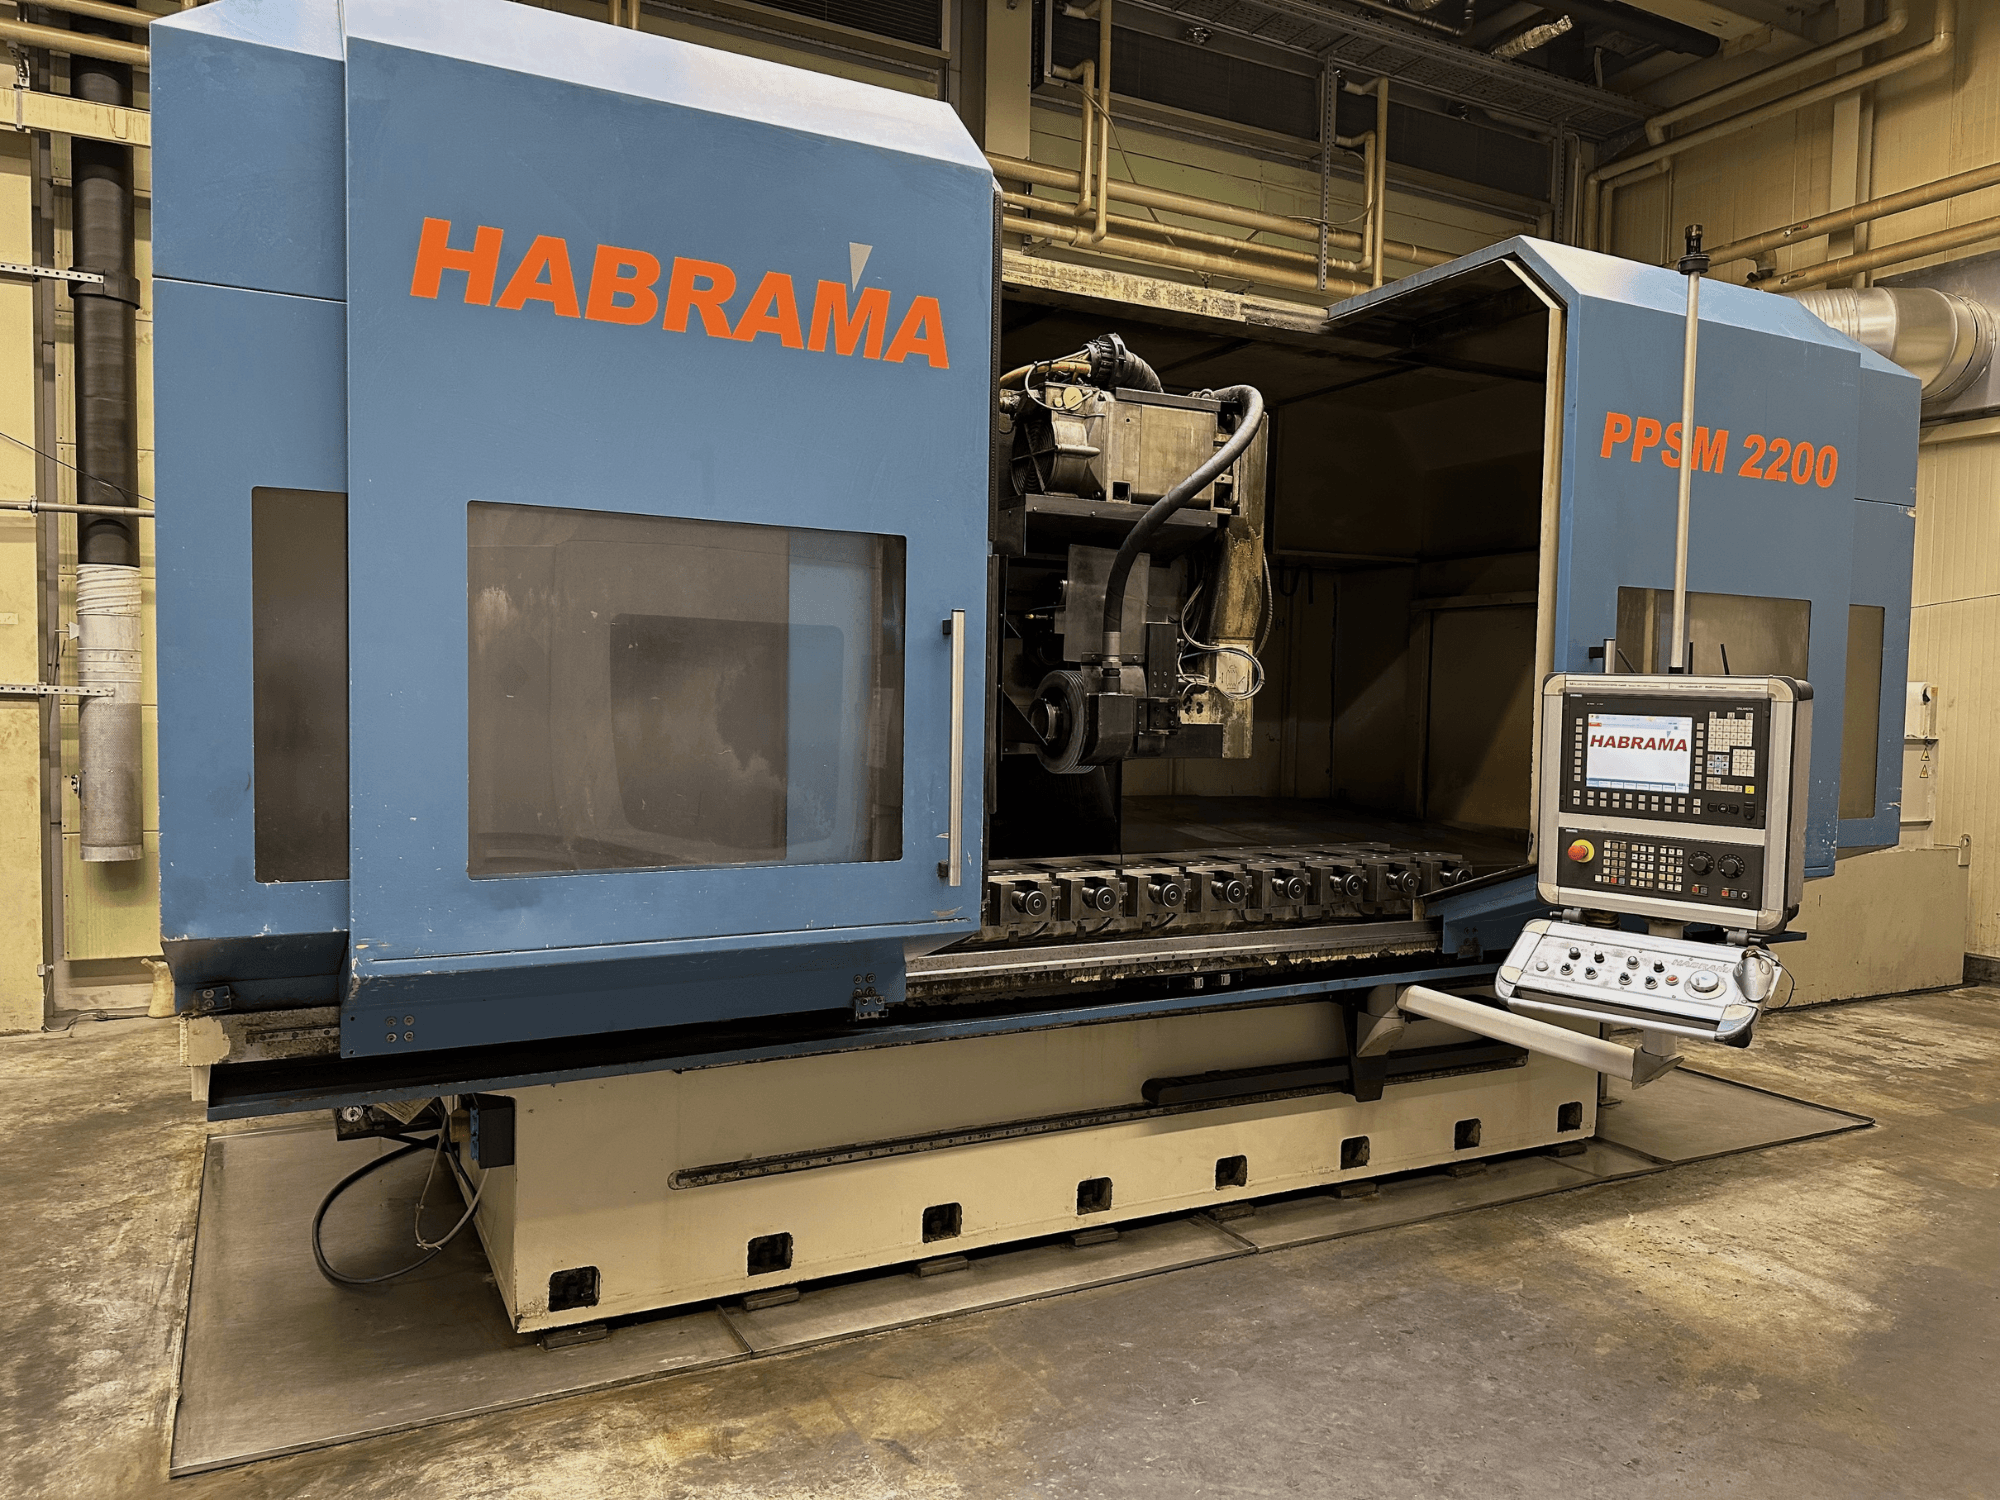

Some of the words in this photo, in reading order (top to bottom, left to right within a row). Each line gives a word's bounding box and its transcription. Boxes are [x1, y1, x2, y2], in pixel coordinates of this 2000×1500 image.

[410, 216, 949, 369] HABRAMA
[1600, 411, 1729, 474] PPSM
[1738, 434, 1838, 488] 2200
[1590, 735, 1687, 752] HABRAMA
